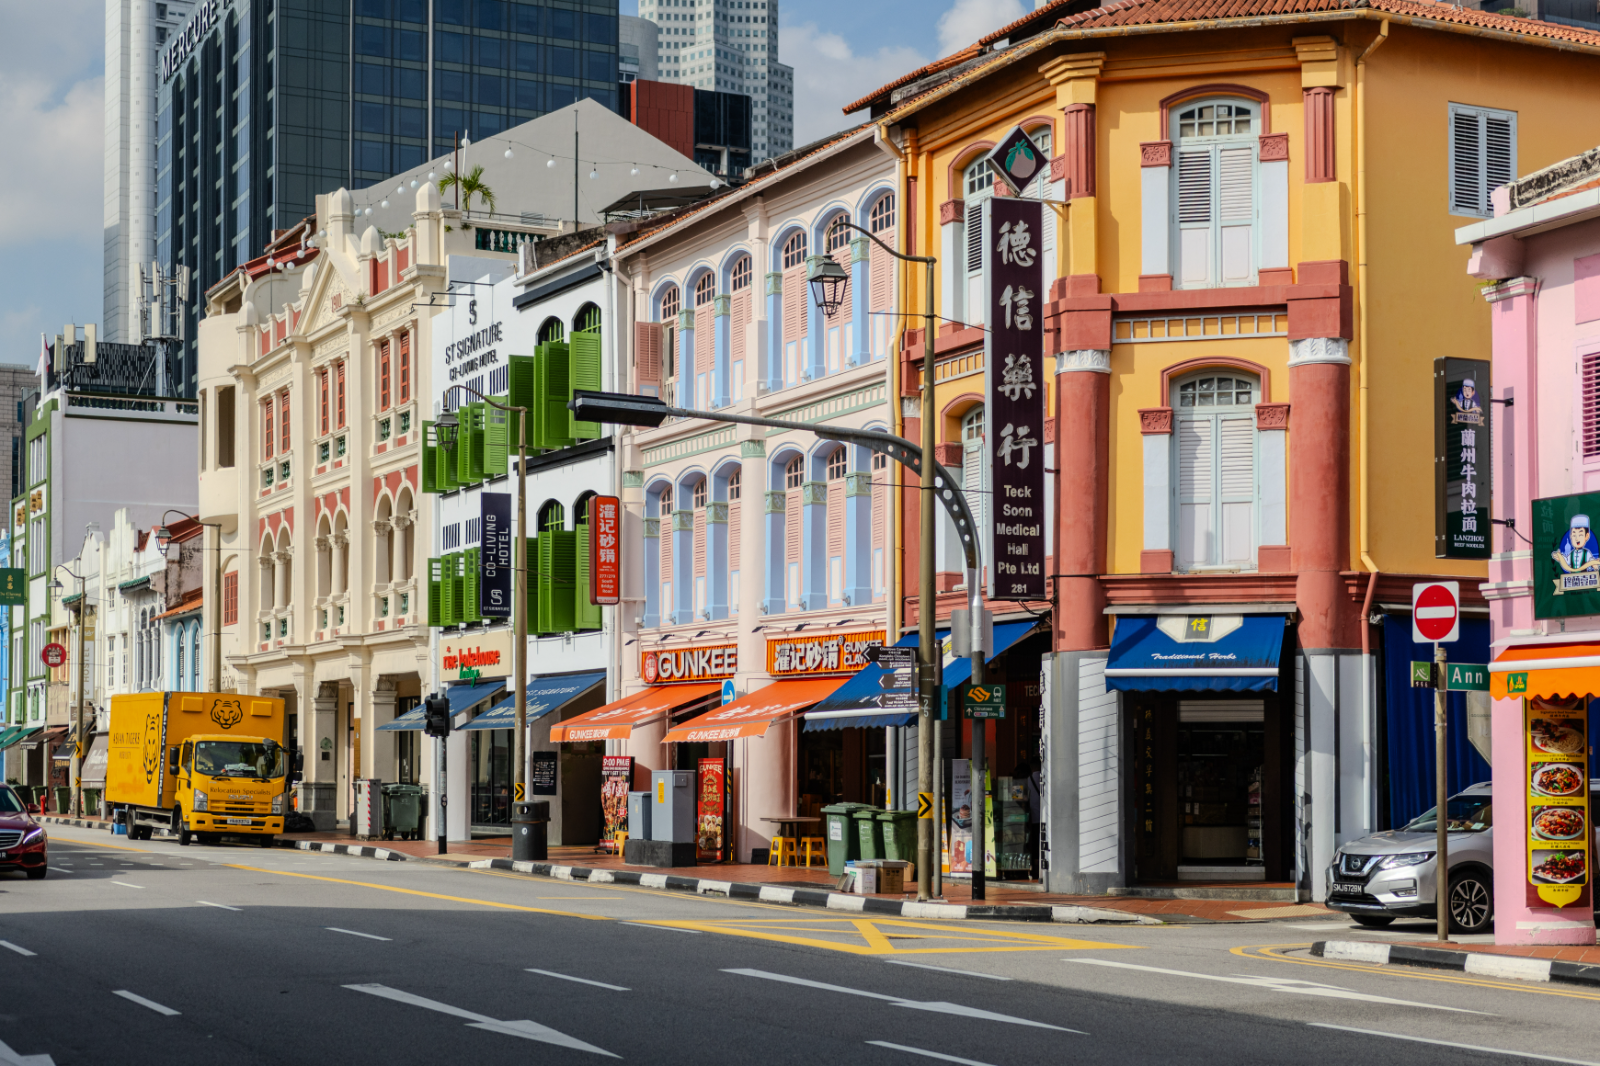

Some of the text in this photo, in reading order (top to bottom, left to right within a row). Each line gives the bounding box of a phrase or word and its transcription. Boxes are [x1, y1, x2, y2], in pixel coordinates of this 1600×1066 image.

[162, 0, 218, 84] MERCURE
[445, 321, 503, 366] ST SIGNATURE
[479, 348, 499, 368] HOTEL
[1460, 428, 1478, 533] 蘭州牛肉拉面
[1003, 485, 1032, 498] Teck
[1003, 504, 1032, 517] Soon
[996, 523, 1040, 537] Medical
[1453, 534, 1484, 542] LANZHOU
[486, 514, 496, 577] CO-LIVING
[498, 527, 509, 566] HOTEL
[1007, 543, 1029, 555] Hall
[997, 562, 1040, 575] Pte Ltd
[1011, 584, 1027, 594] 281
[1191, 618, 1207, 632] 信
[658, 648, 737, 679] GUNKEE
[1452, 667, 1483, 684] Ann
[113, 733, 140, 745] ASIAN TIGERS
[569, 729, 592, 740] GUNKEE
[687, 730, 719, 740] GUNKEE
[242, 788, 271, 796] Specialists
